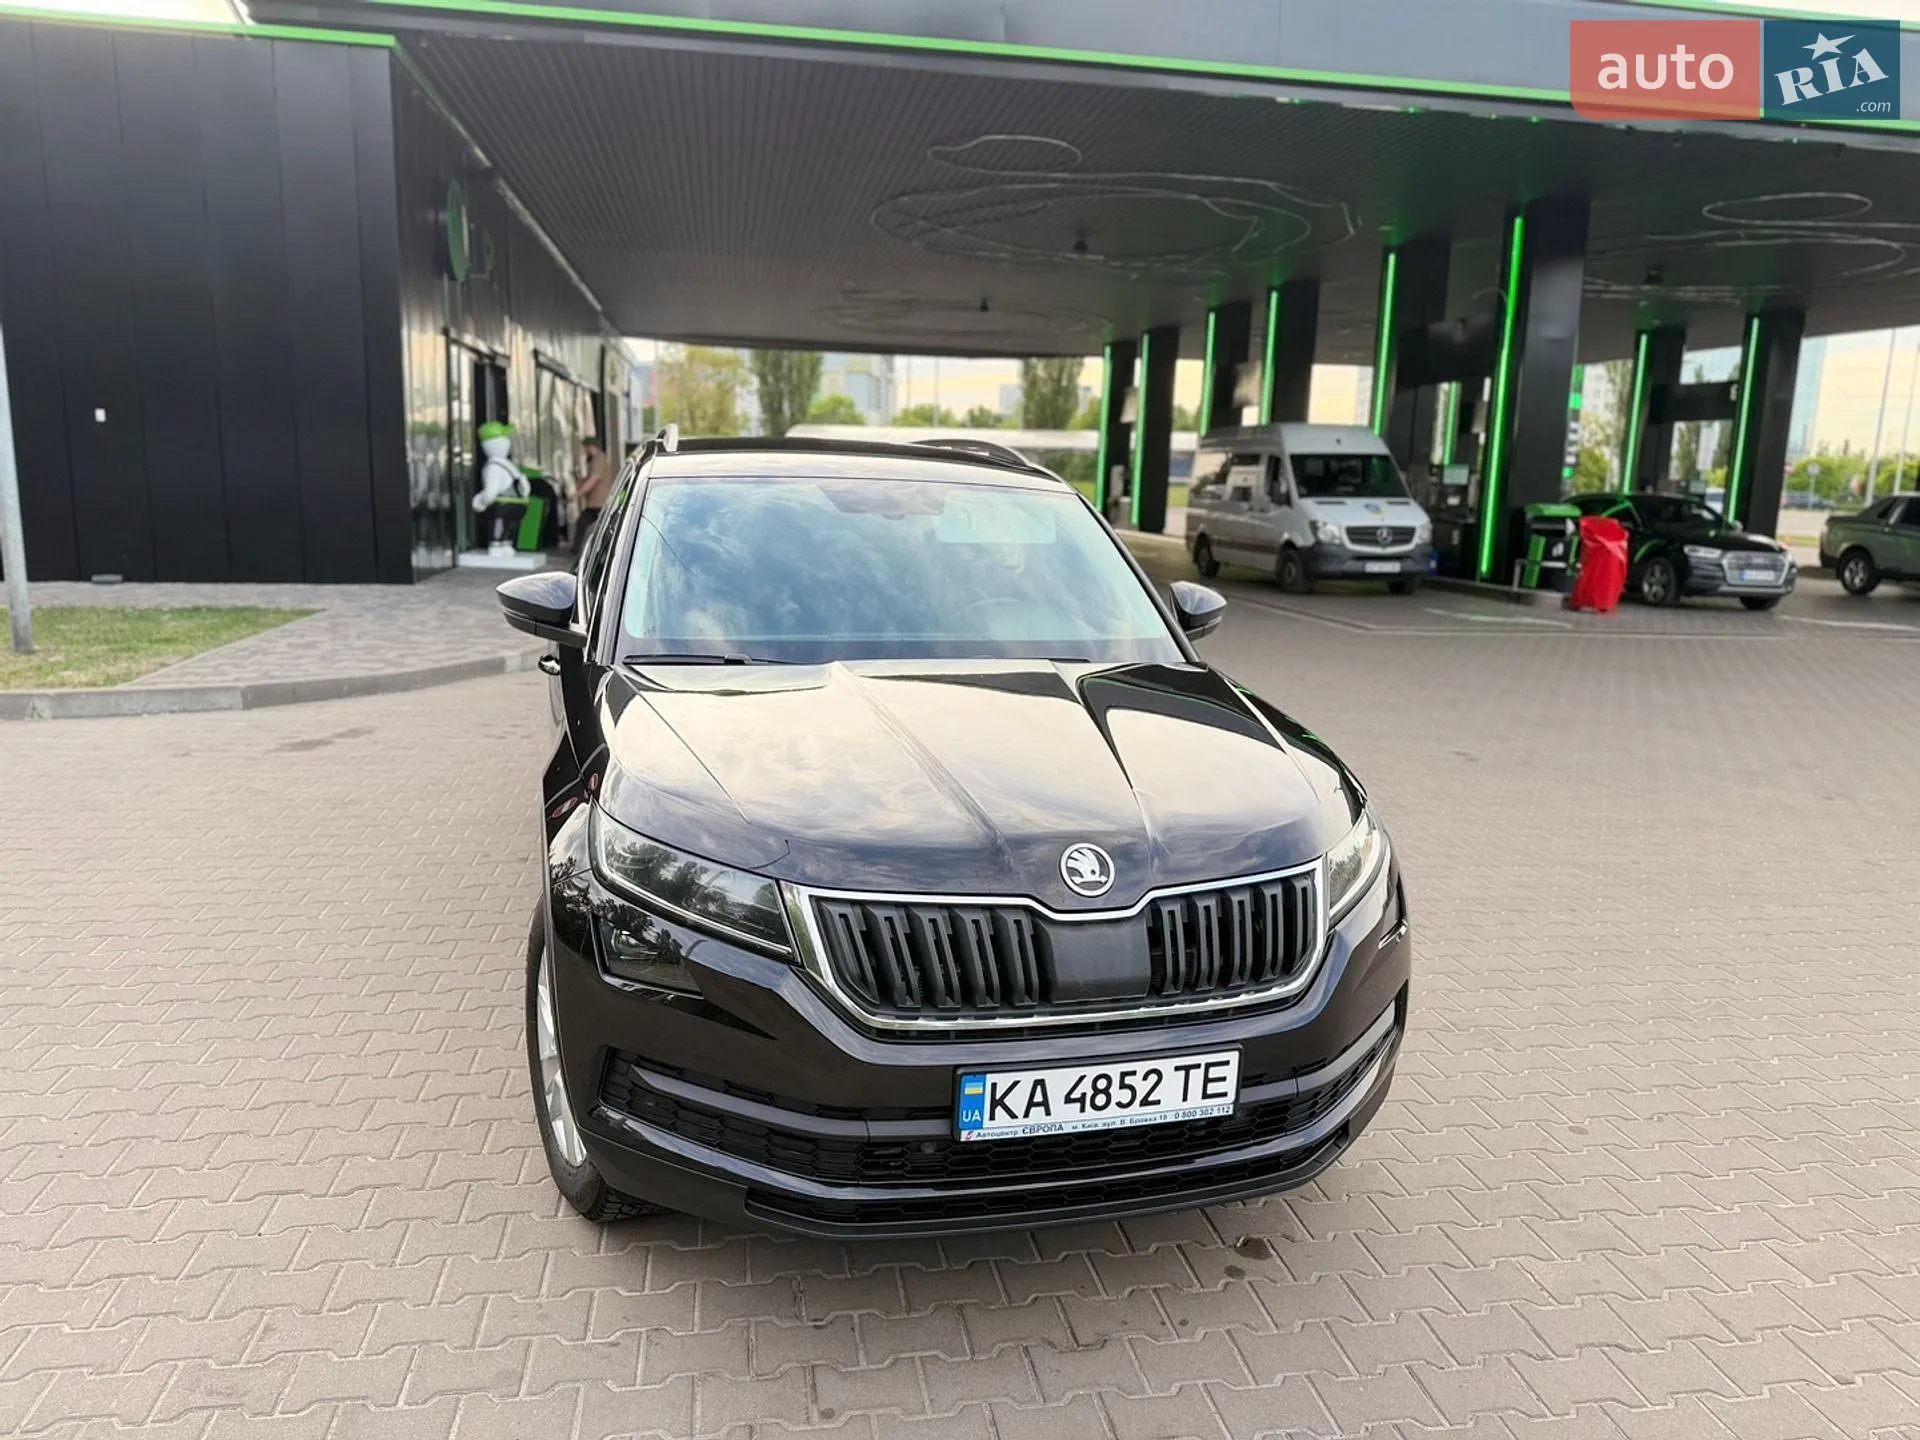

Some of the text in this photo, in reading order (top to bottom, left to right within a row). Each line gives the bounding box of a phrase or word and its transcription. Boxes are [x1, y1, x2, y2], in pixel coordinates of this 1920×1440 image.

[988, 1060, 1231, 1121] KA 4852 TE
[962, 1110, 982, 1123] UA
[1022, 1123, 1064, 1135] ЄВРОПА
[1217, 1105, 1231, 1115] 112
